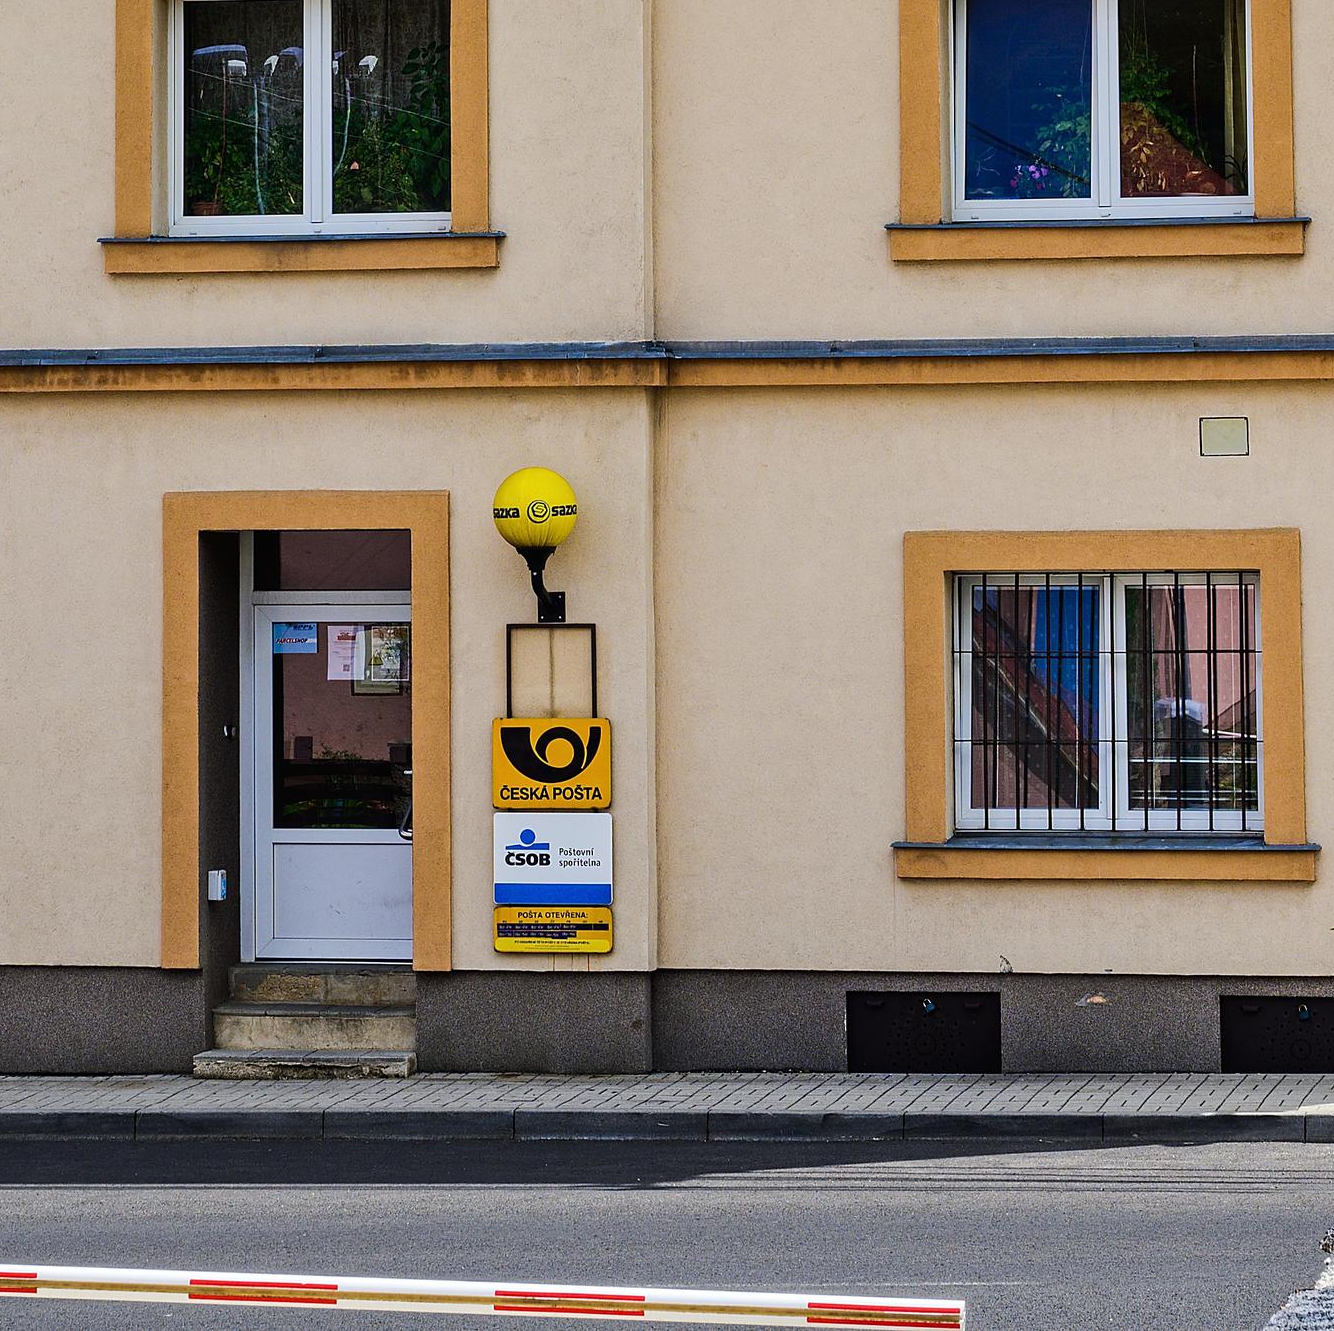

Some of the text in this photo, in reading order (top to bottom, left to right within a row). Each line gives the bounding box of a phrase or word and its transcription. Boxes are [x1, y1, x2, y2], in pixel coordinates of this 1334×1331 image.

[551, 504, 577, 517] sazk
[500, 785, 602, 800] ČESKÁ POŠTA
[558, 847, 595, 856] Poštovní
[505, 851, 551, 866] ČSOB
[558, 858, 601, 868] spořitelna
[517, 910, 543, 919] POŠTA
